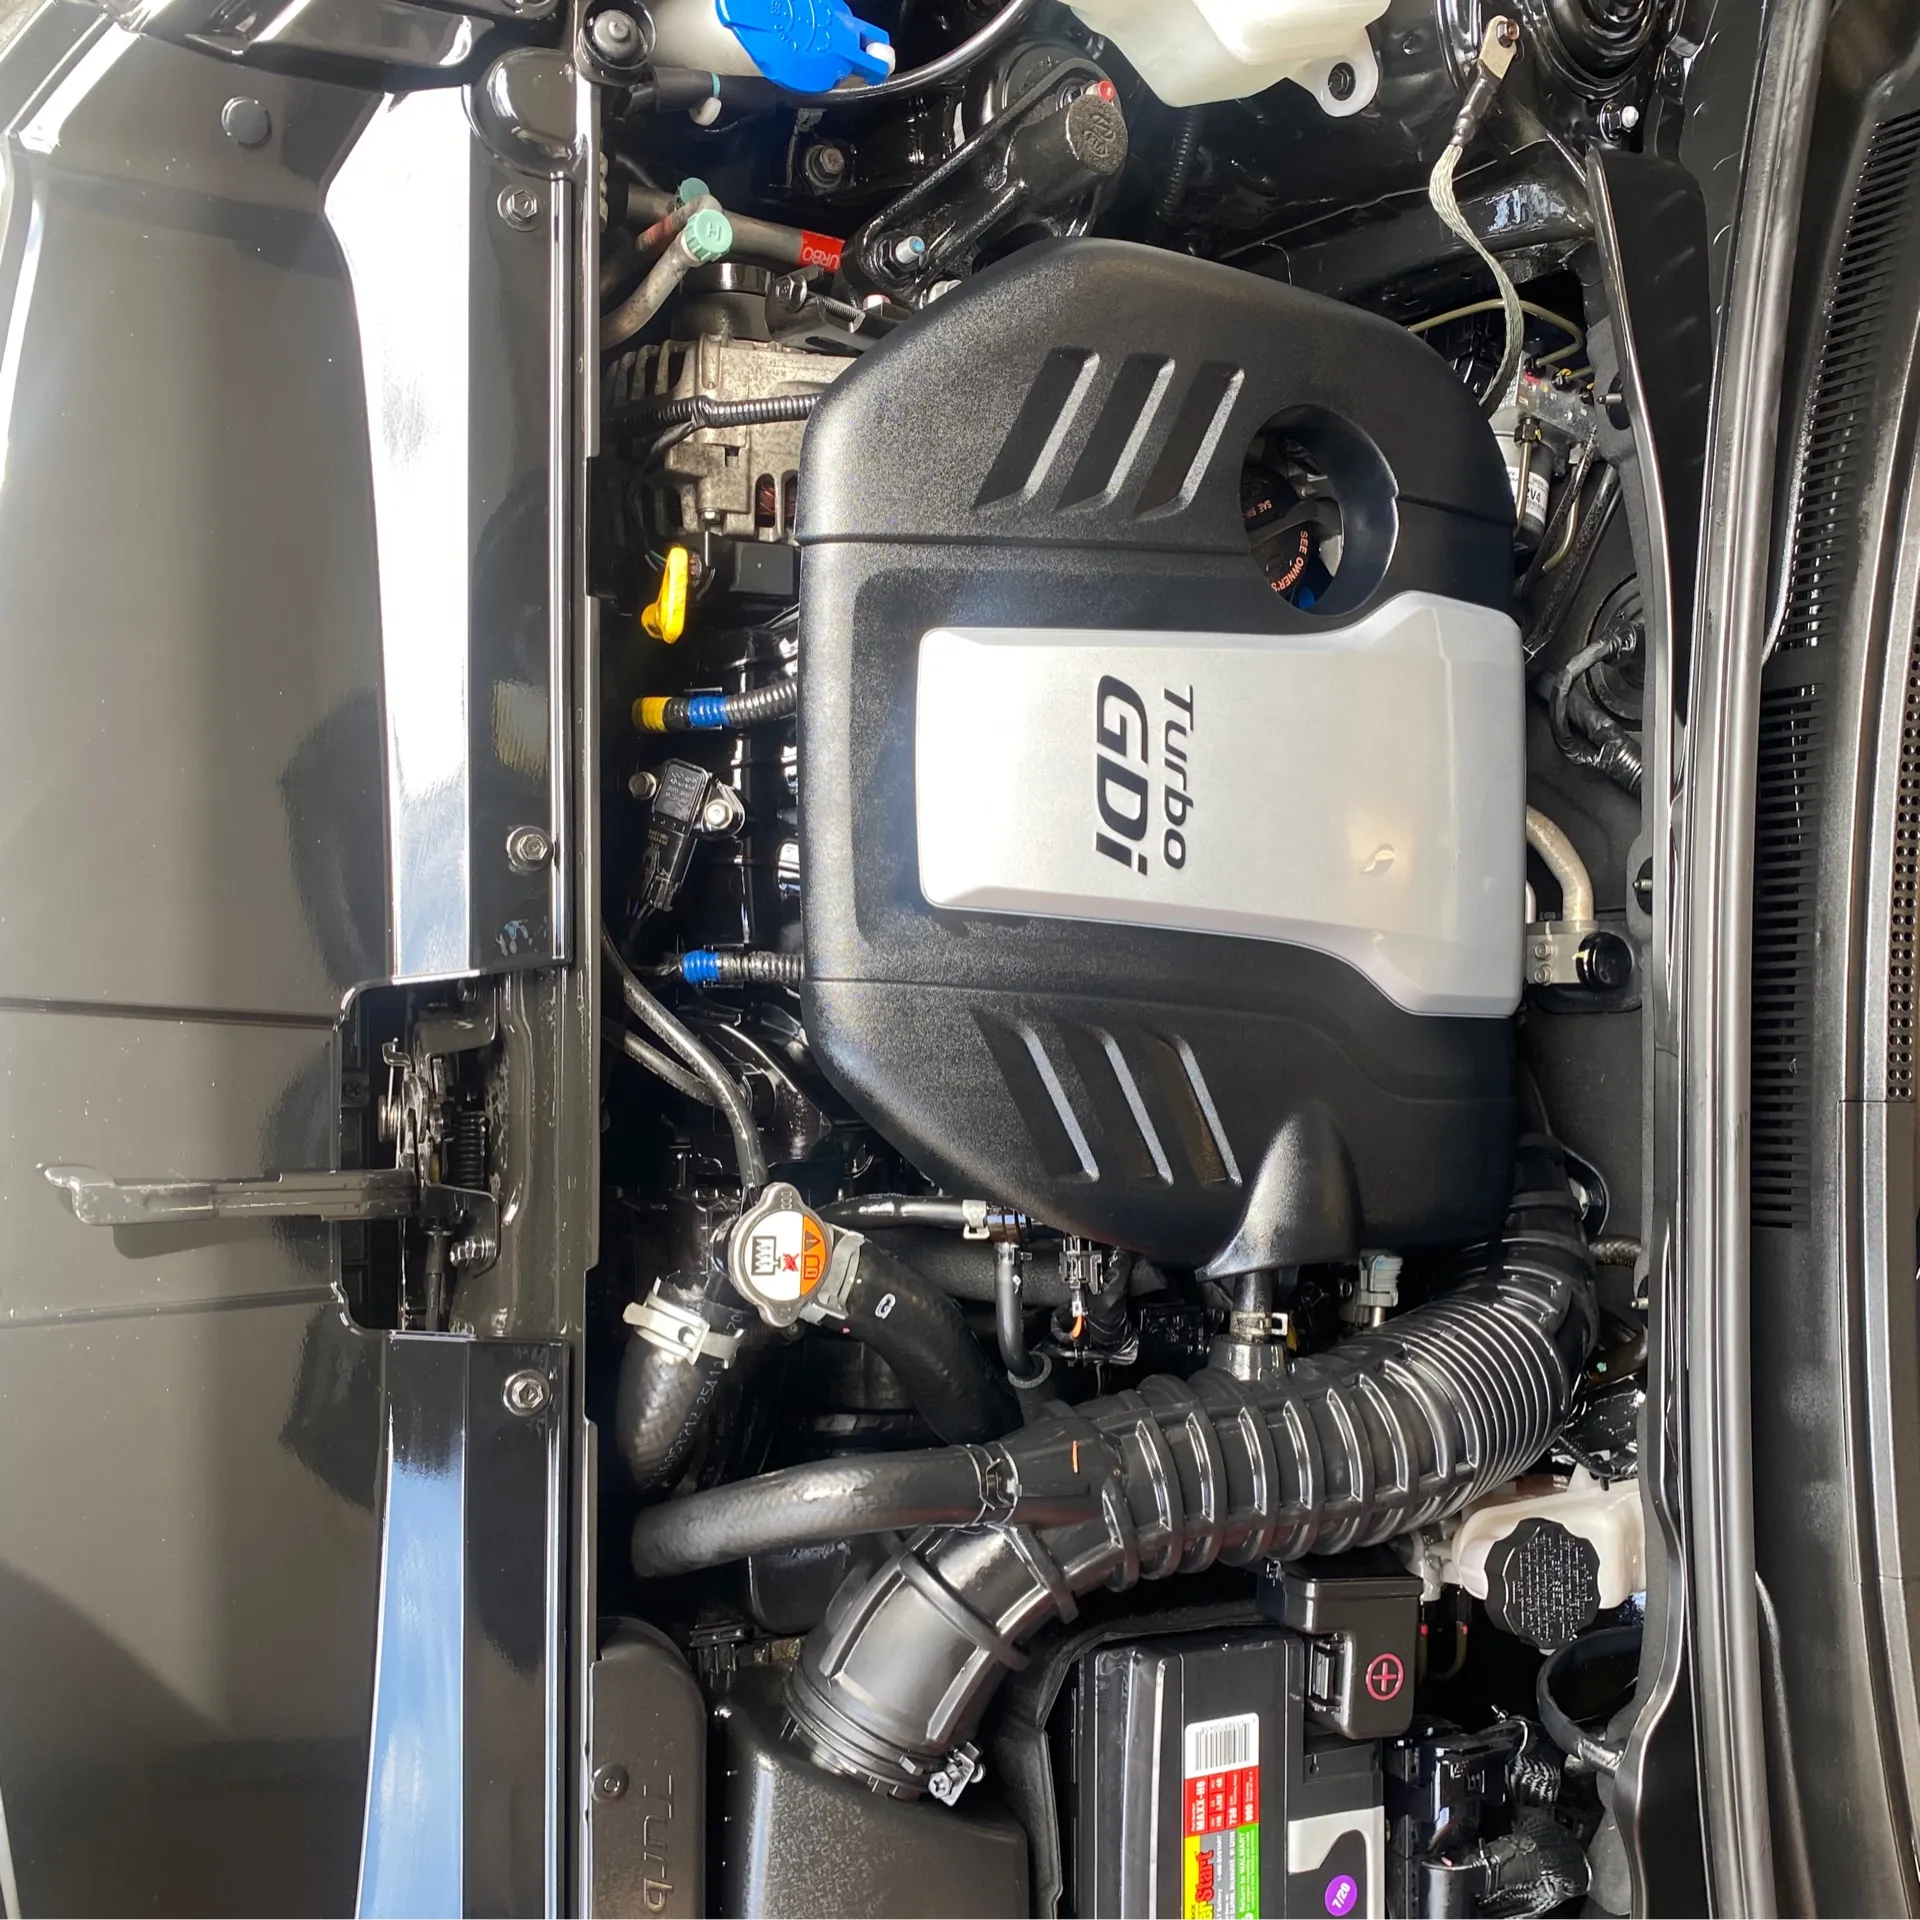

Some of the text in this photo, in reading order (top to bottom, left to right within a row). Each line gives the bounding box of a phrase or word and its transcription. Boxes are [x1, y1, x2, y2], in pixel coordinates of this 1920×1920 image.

[1257, 499, 1273, 514] SAE
[1271, 530, 1309, 593] SEE OWNER'S
[1096, 674, 1149, 876] GDi
[1163, 684, 1194, 870] Turbo
[1195, 1780, 1206, 1831] MAXX-H6
[1228, 1807, 1238, 1826] 730
[643, 1773, 674, 1914] Turb
[1331, 1881, 1351, 1910] 7/20
